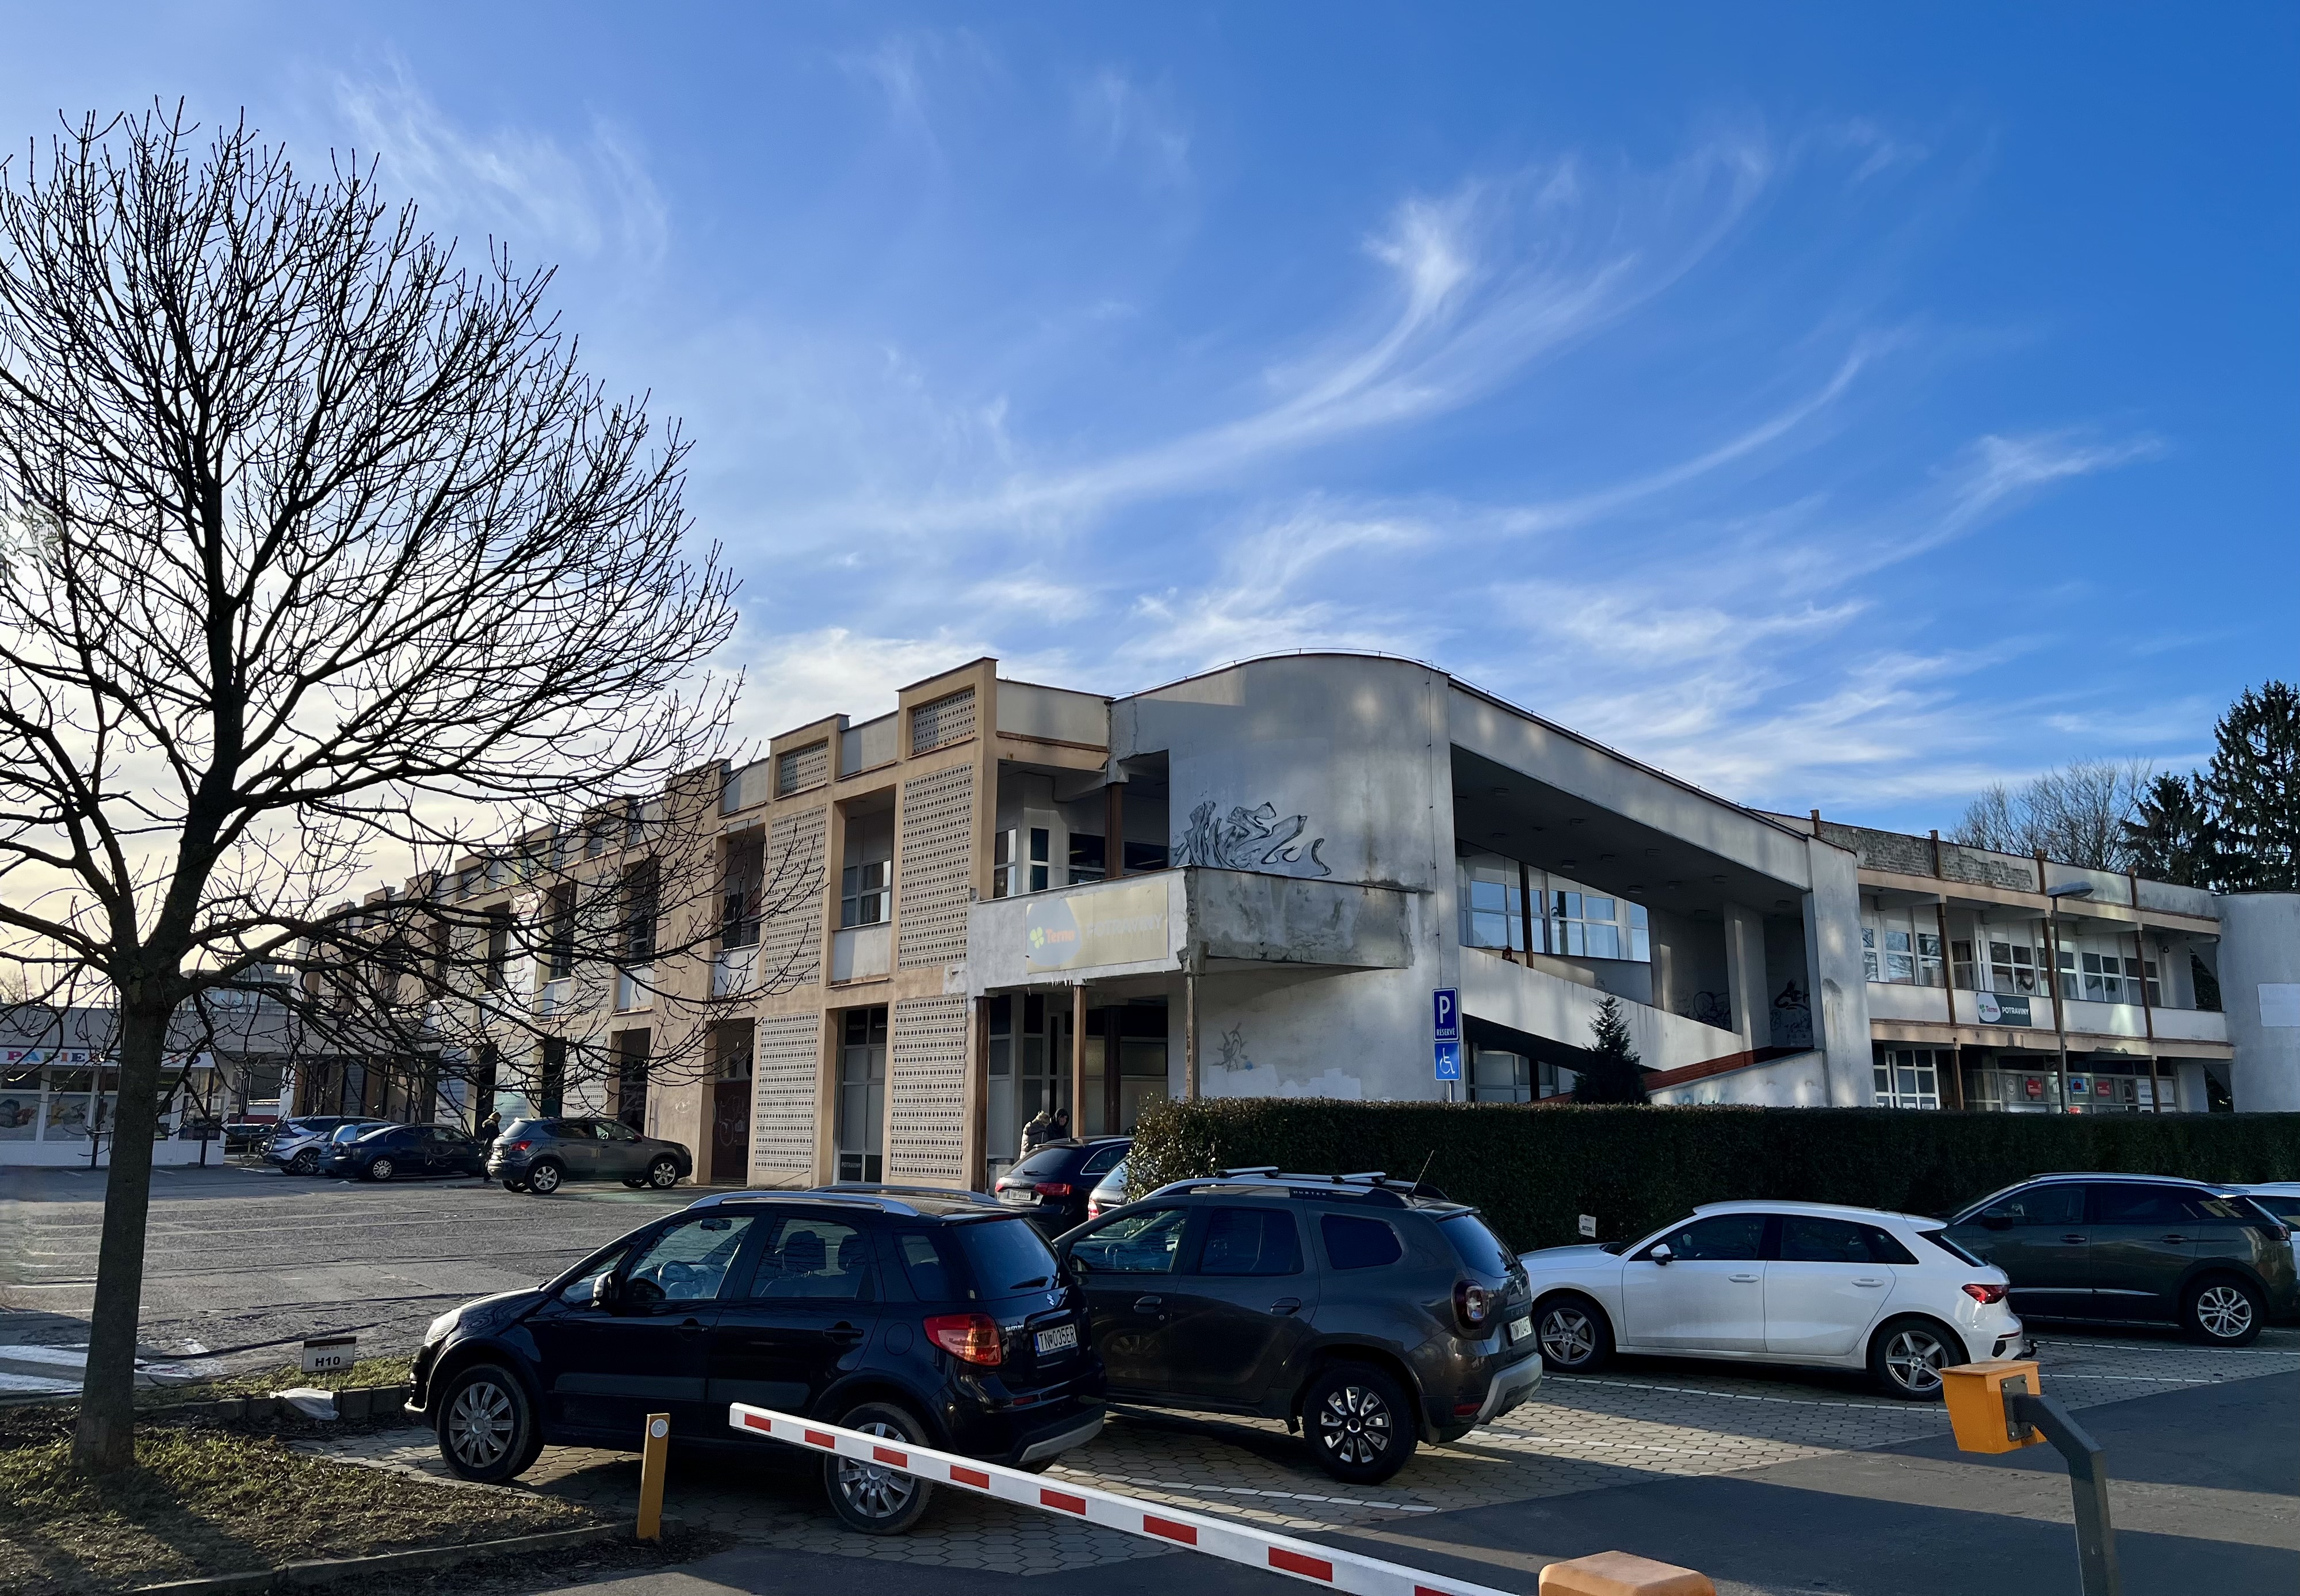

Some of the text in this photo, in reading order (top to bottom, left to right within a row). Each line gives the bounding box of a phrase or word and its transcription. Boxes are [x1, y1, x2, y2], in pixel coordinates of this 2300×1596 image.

[1087, 912, 1163, 938] POTRAVINY
[1439, 996, 1450, 1024] P
[2002, 1006, 2028, 1015] POTRAVINY
[1436, 1027, 1455, 1036] RÉSERVÉ
[315, 1356, 341, 1367] H10
